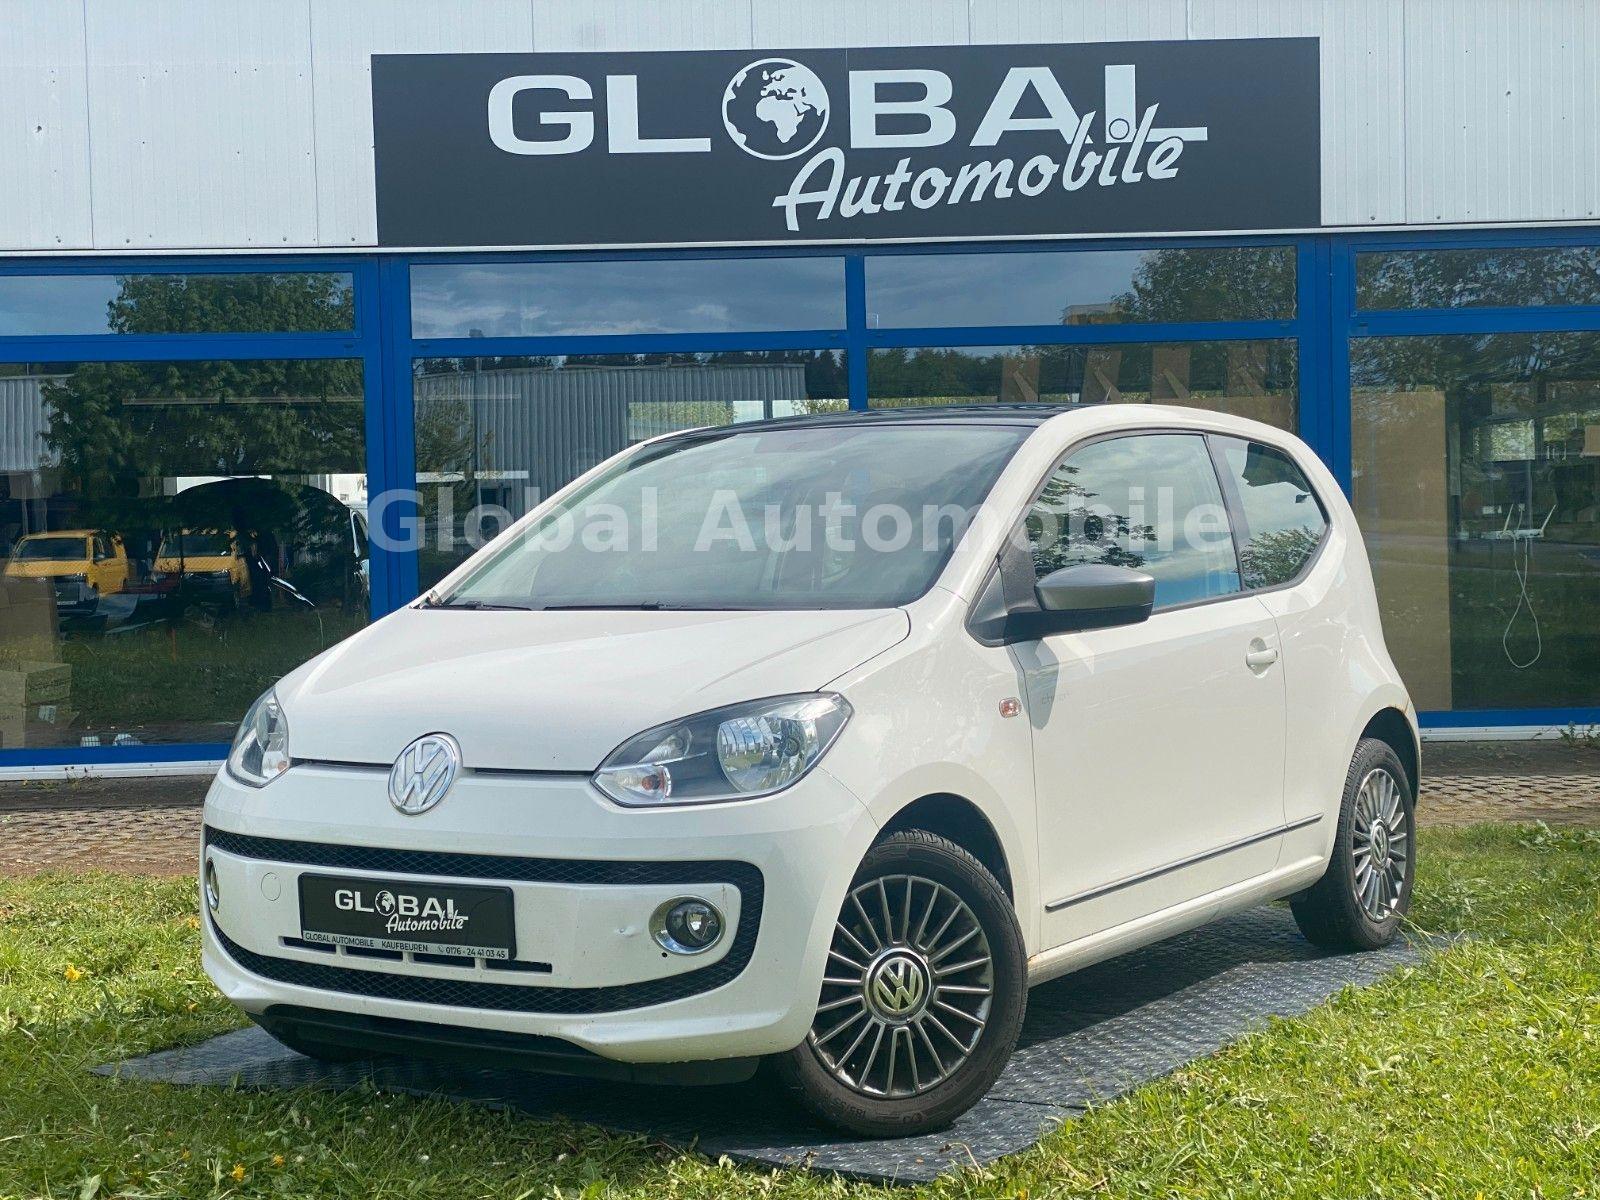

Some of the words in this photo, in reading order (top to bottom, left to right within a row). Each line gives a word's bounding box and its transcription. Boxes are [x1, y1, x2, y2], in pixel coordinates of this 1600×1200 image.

[488, 57, 1208, 161] GLOBAL
[773, 101, 1184, 232] Automobile
[305, 932, 330, 942] GLOBAL
[331, 935, 375, 948] AUTOMOBILE
[381, 940, 428, 952] KAUFBEUREN
[445, 946, 461, 955] 0176
[467, 947, 476, 956] 24
[477, 948, 485, 957] 41
[486, 948, 495, 958] 03
[496, 949, 506, 959] 45
[385, 908, 464, 933] Automobile
